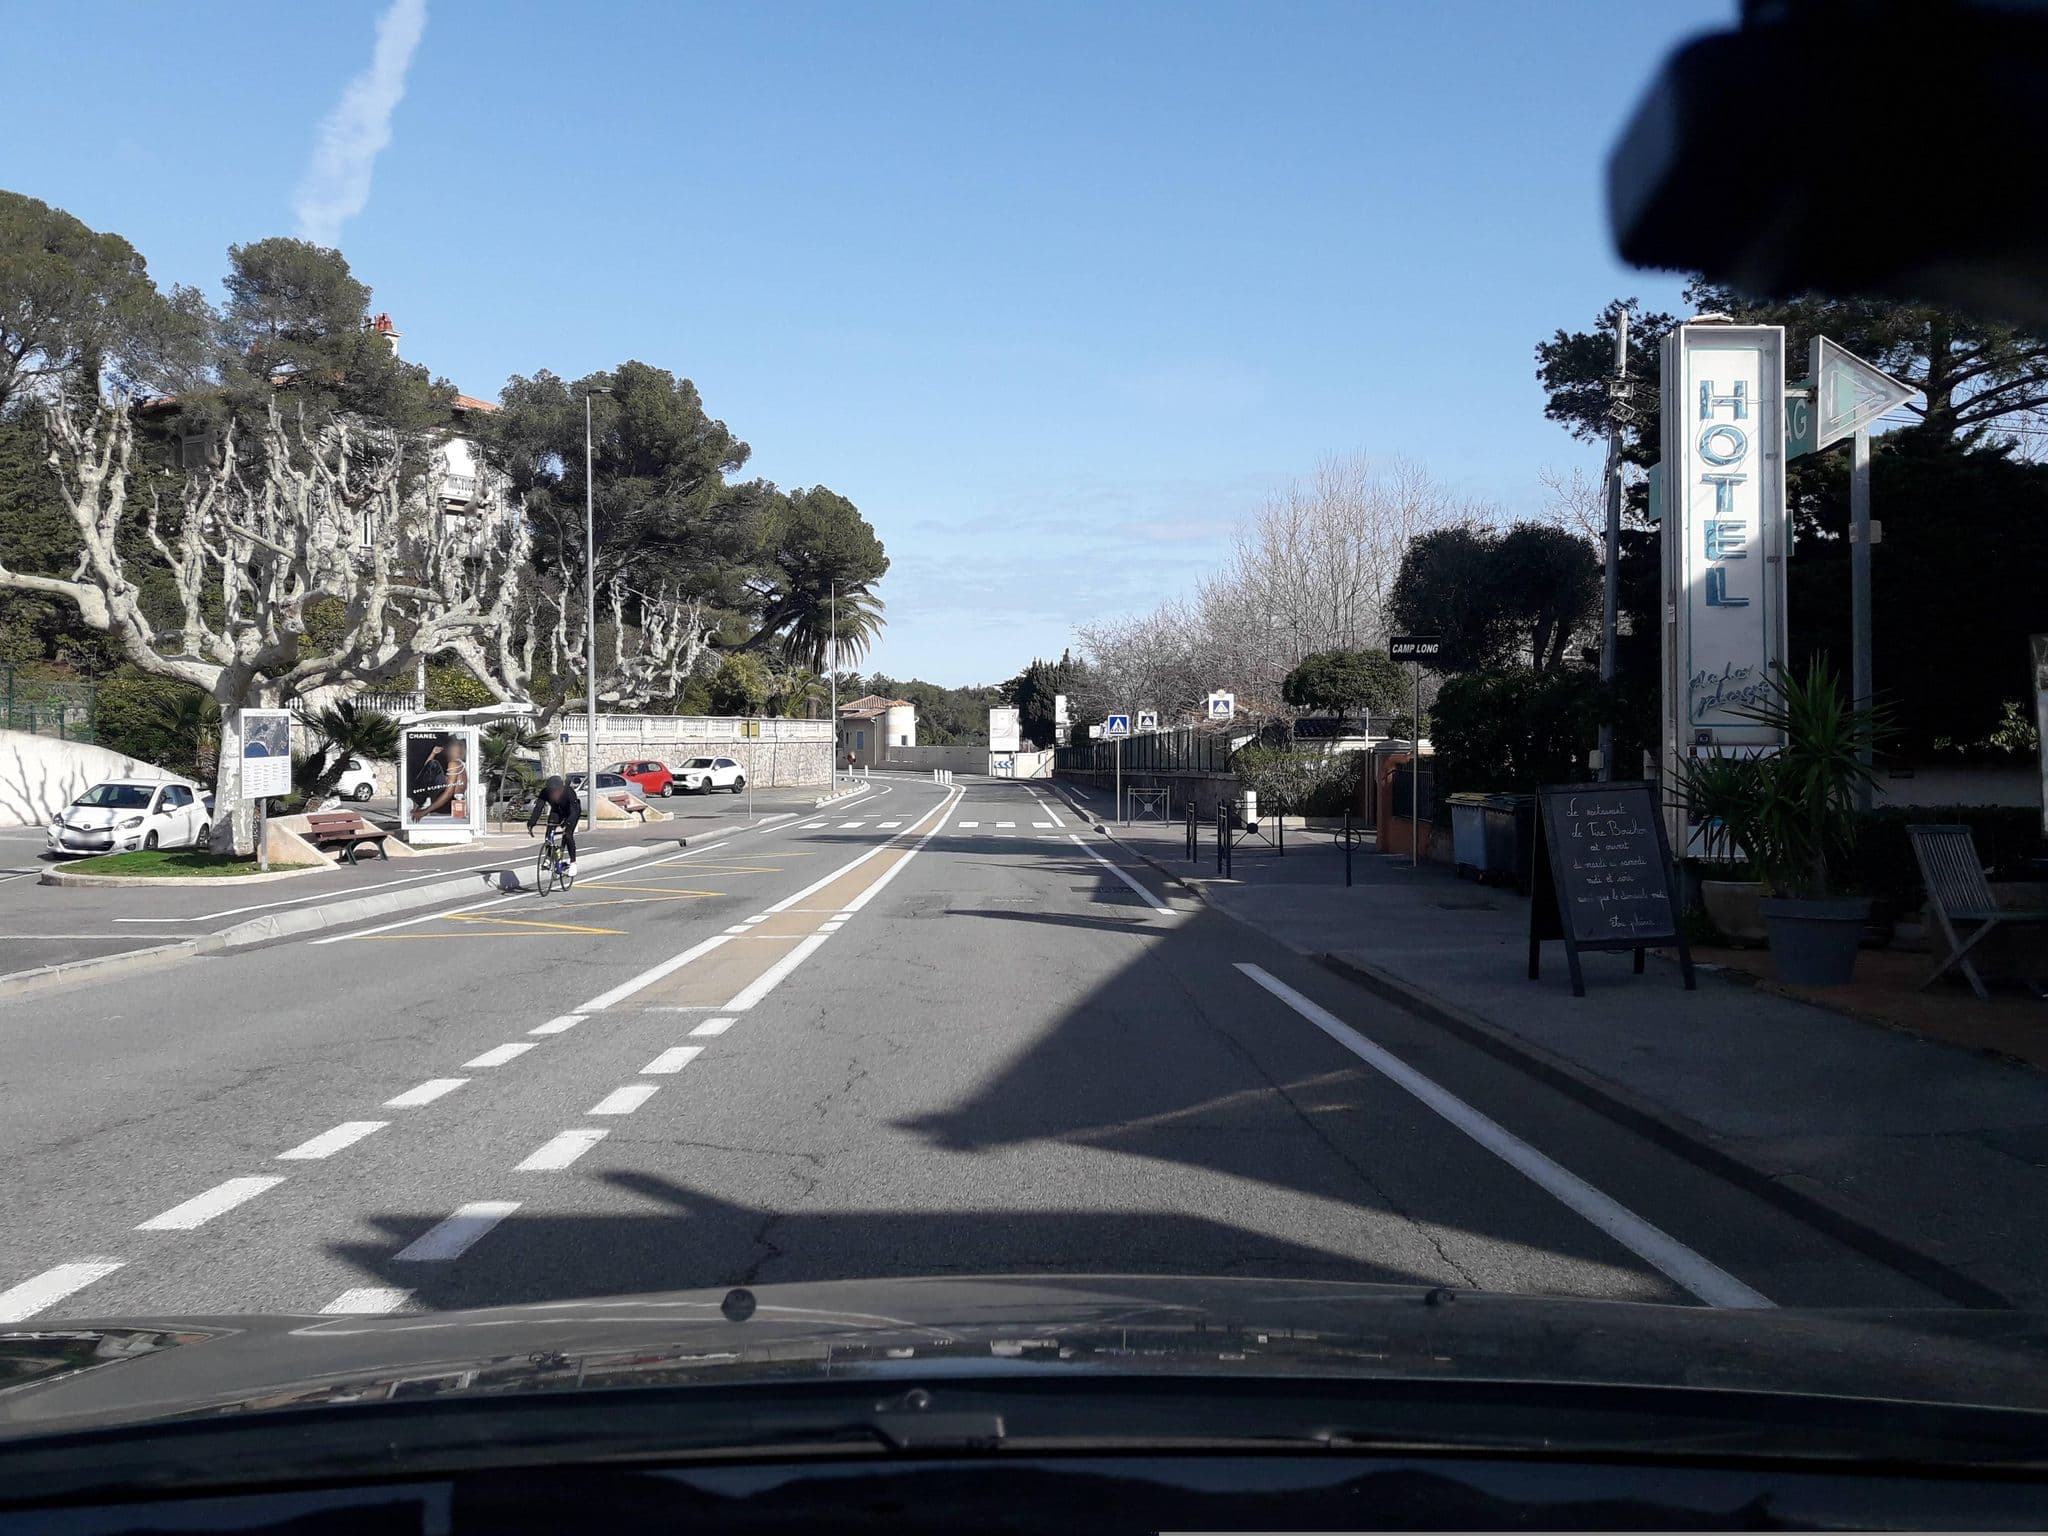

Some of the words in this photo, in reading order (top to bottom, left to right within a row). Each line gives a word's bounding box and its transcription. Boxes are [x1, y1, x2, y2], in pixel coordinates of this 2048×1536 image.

[1697, 379, 1750, 606] HOTEL
[1392, 643, 1416, 654] CAMP
[1416, 643, 1439, 654] LONG
